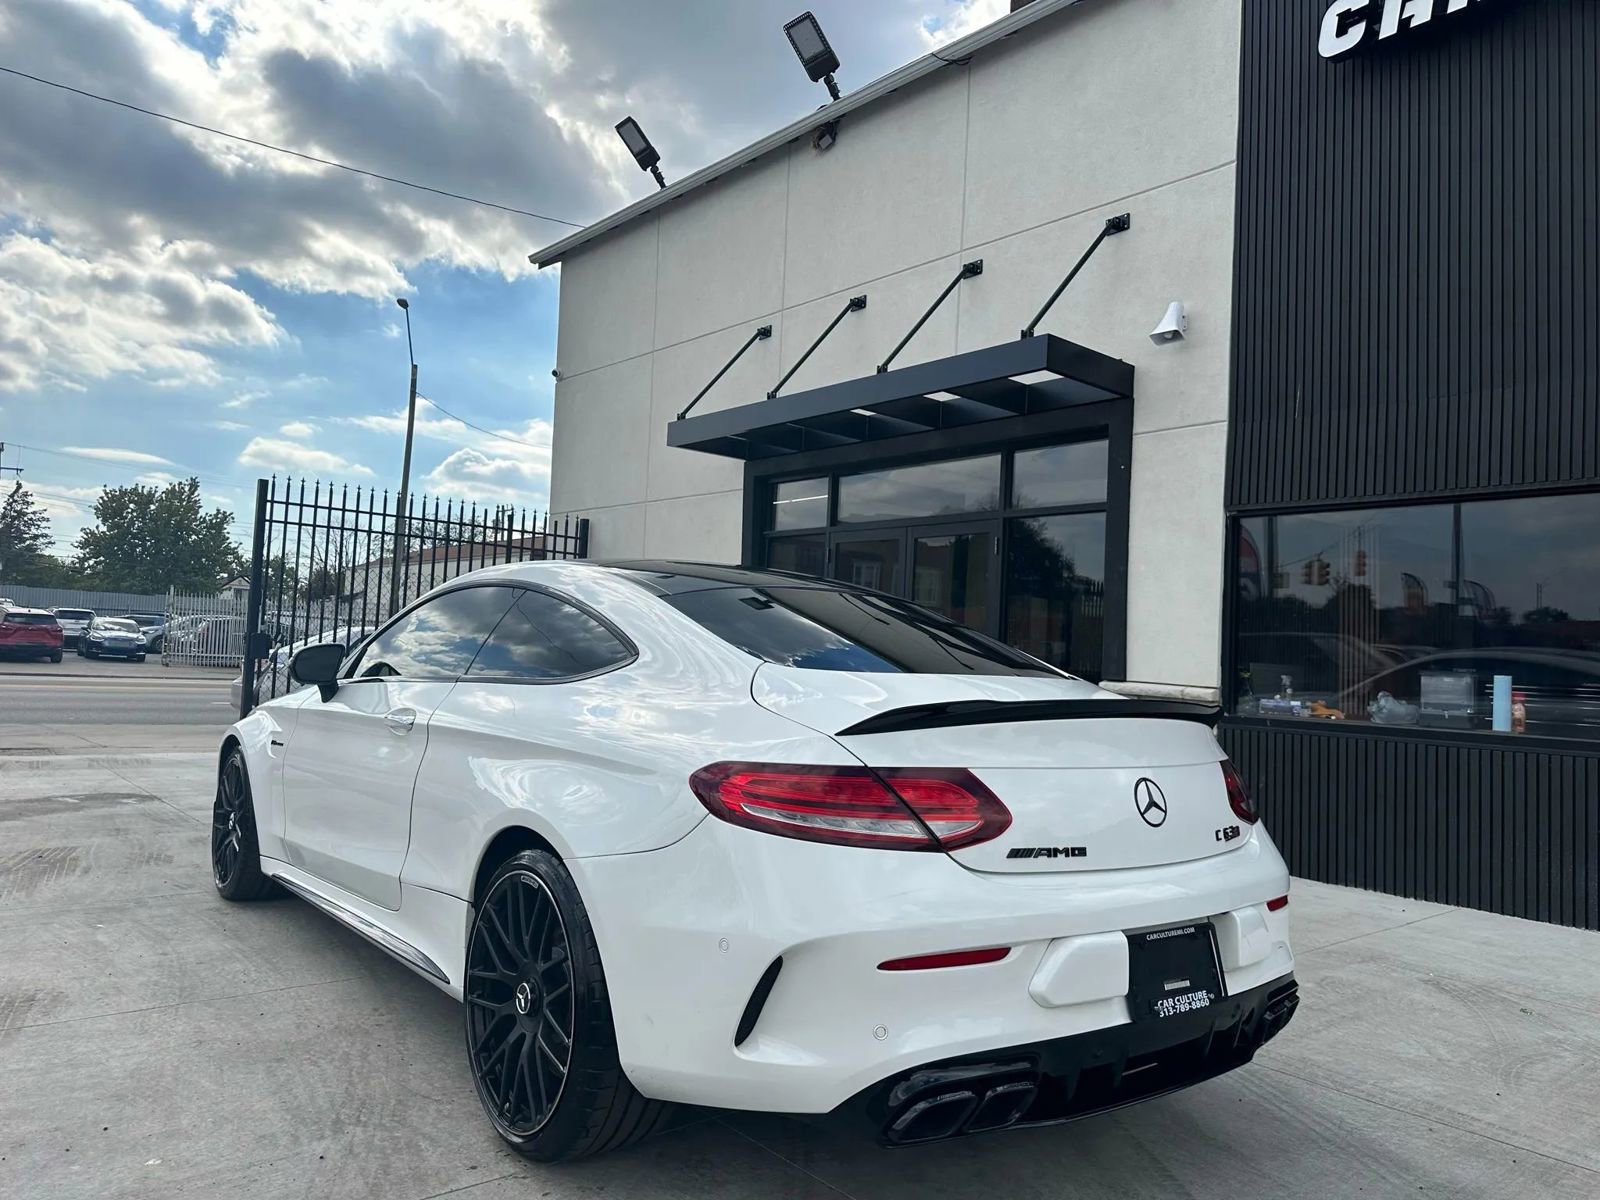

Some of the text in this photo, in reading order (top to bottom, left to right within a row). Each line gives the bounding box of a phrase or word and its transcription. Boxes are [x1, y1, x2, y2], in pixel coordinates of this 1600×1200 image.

[1318, 0, 1481, 58] CA
[1157, 990, 1208, 1008] CAR CULTURE
[1159, 998, 1210, 1018] 313-789-8860
